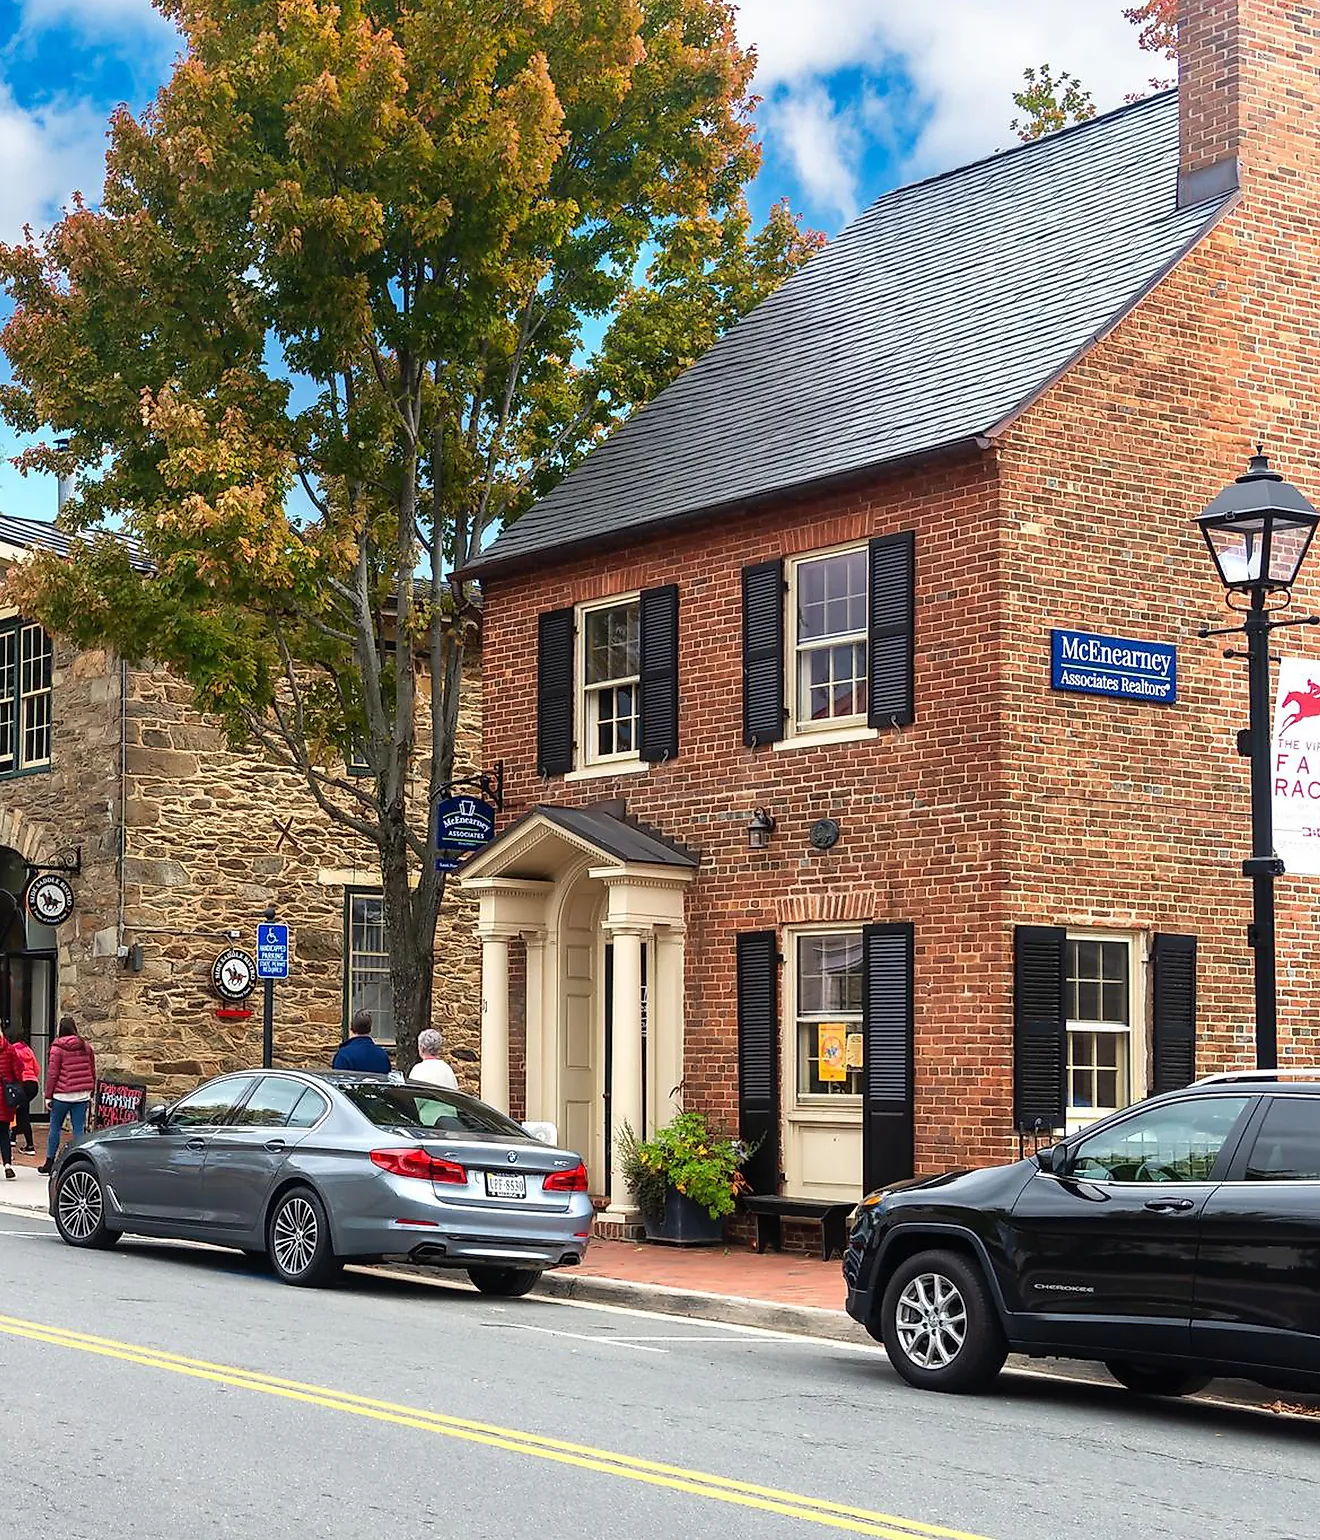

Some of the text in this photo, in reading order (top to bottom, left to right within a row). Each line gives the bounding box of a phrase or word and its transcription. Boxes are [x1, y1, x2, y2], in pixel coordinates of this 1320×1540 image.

[1061, 636, 1172, 676] McEnearney
[1060, 669, 1119, 691] Associates
[1278, 738, 1300, 750] THE
[1275, 777, 1320, 800] RAC
[442, 815, 491, 832] McEnearney
[448, 830, 485, 839] ASSOCIATES
[30, 886, 38, 904] SIDE
[35, 877, 60, 889] SADDLE
[215, 961, 224, 979] SIDE
[220, 951, 245, 962] SADDLE
[261, 952, 284, 961] PARKING
[1033, 1283, 1095, 1293] CHEROKEE
